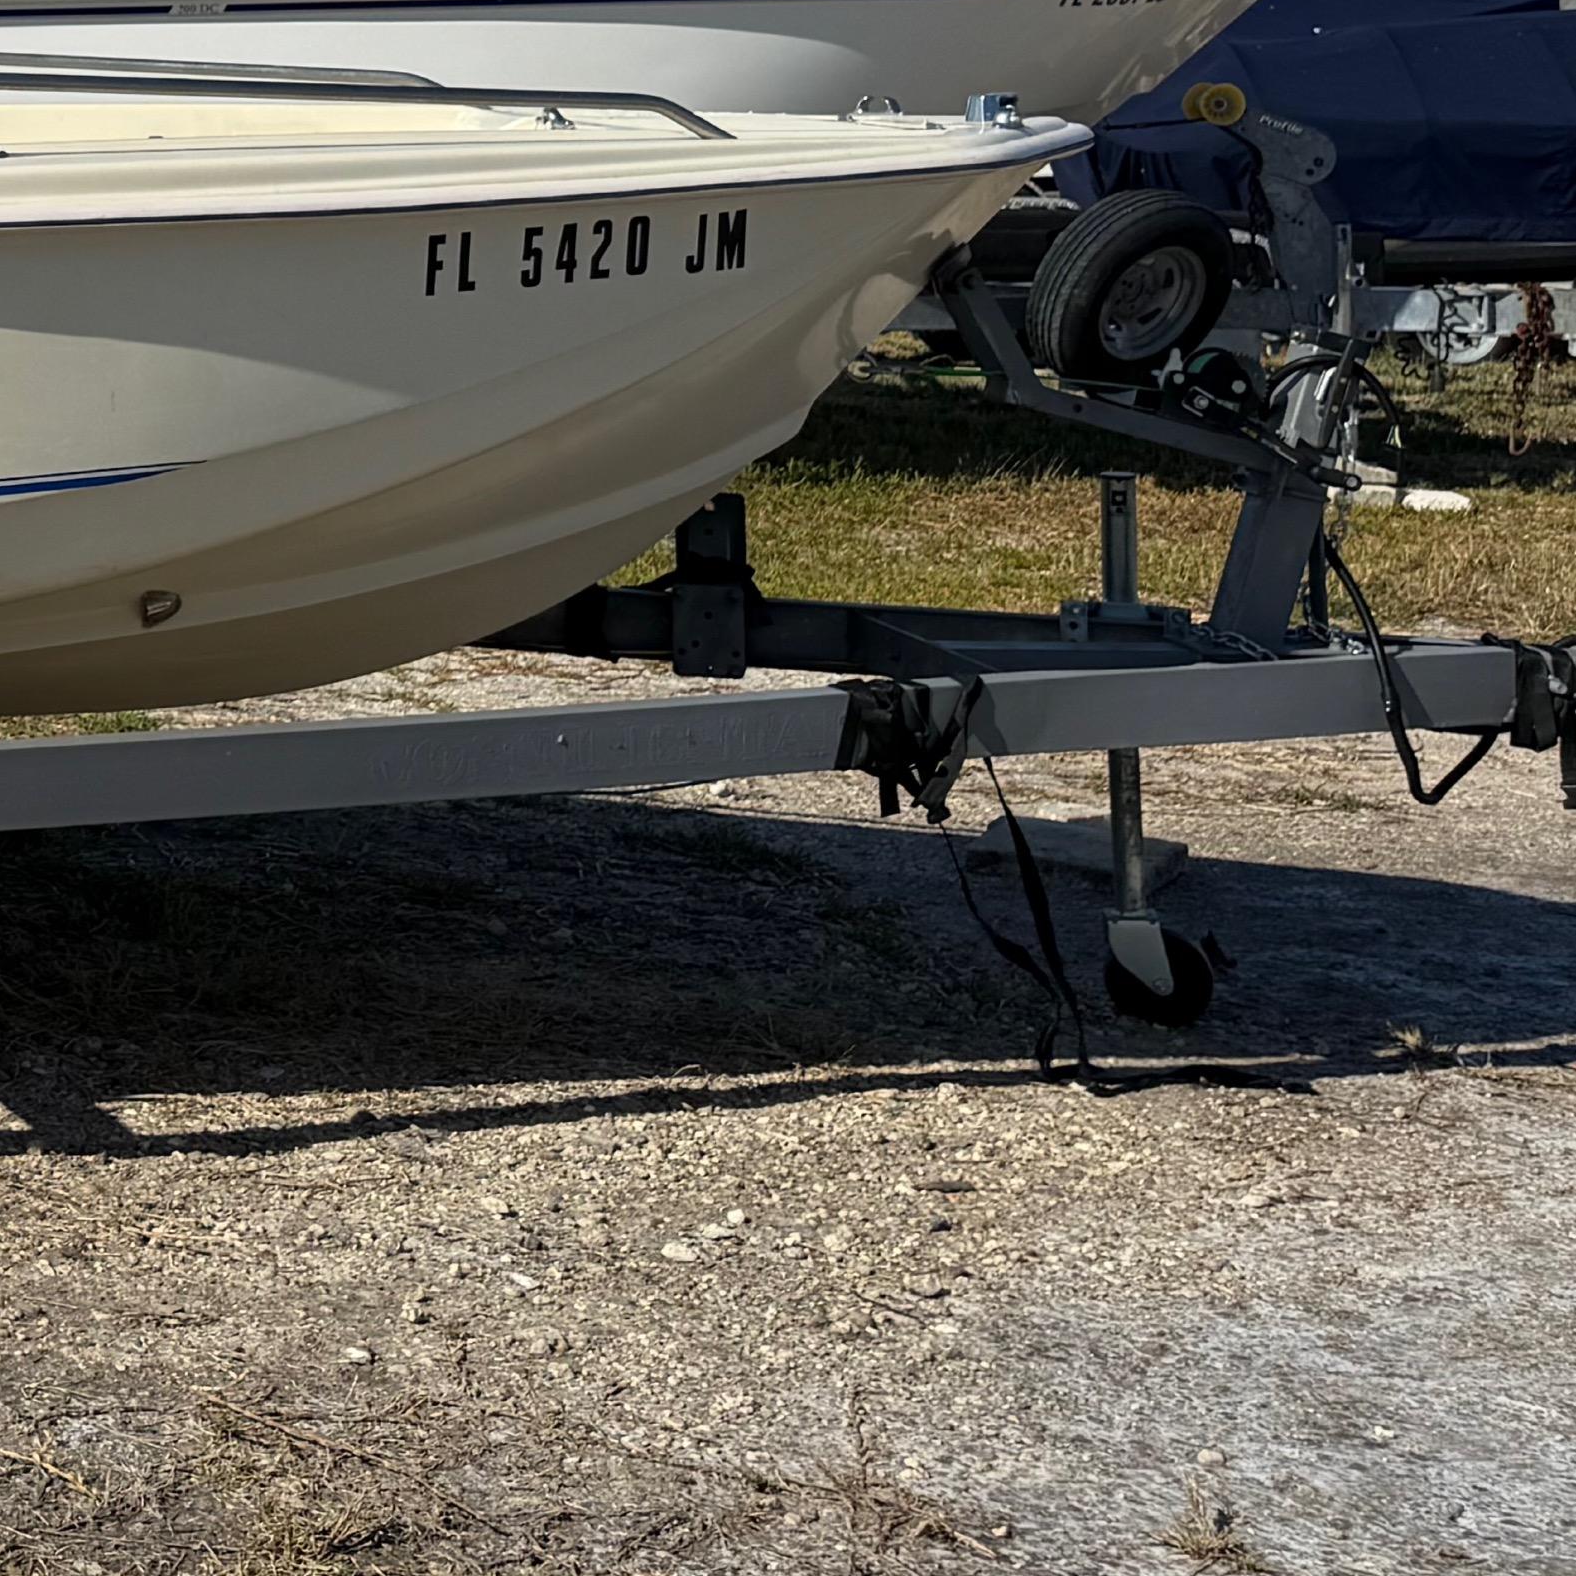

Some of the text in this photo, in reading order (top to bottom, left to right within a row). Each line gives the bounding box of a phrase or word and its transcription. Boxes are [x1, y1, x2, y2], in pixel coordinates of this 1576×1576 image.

[425, 208, 747, 296] FL 5420 JM
